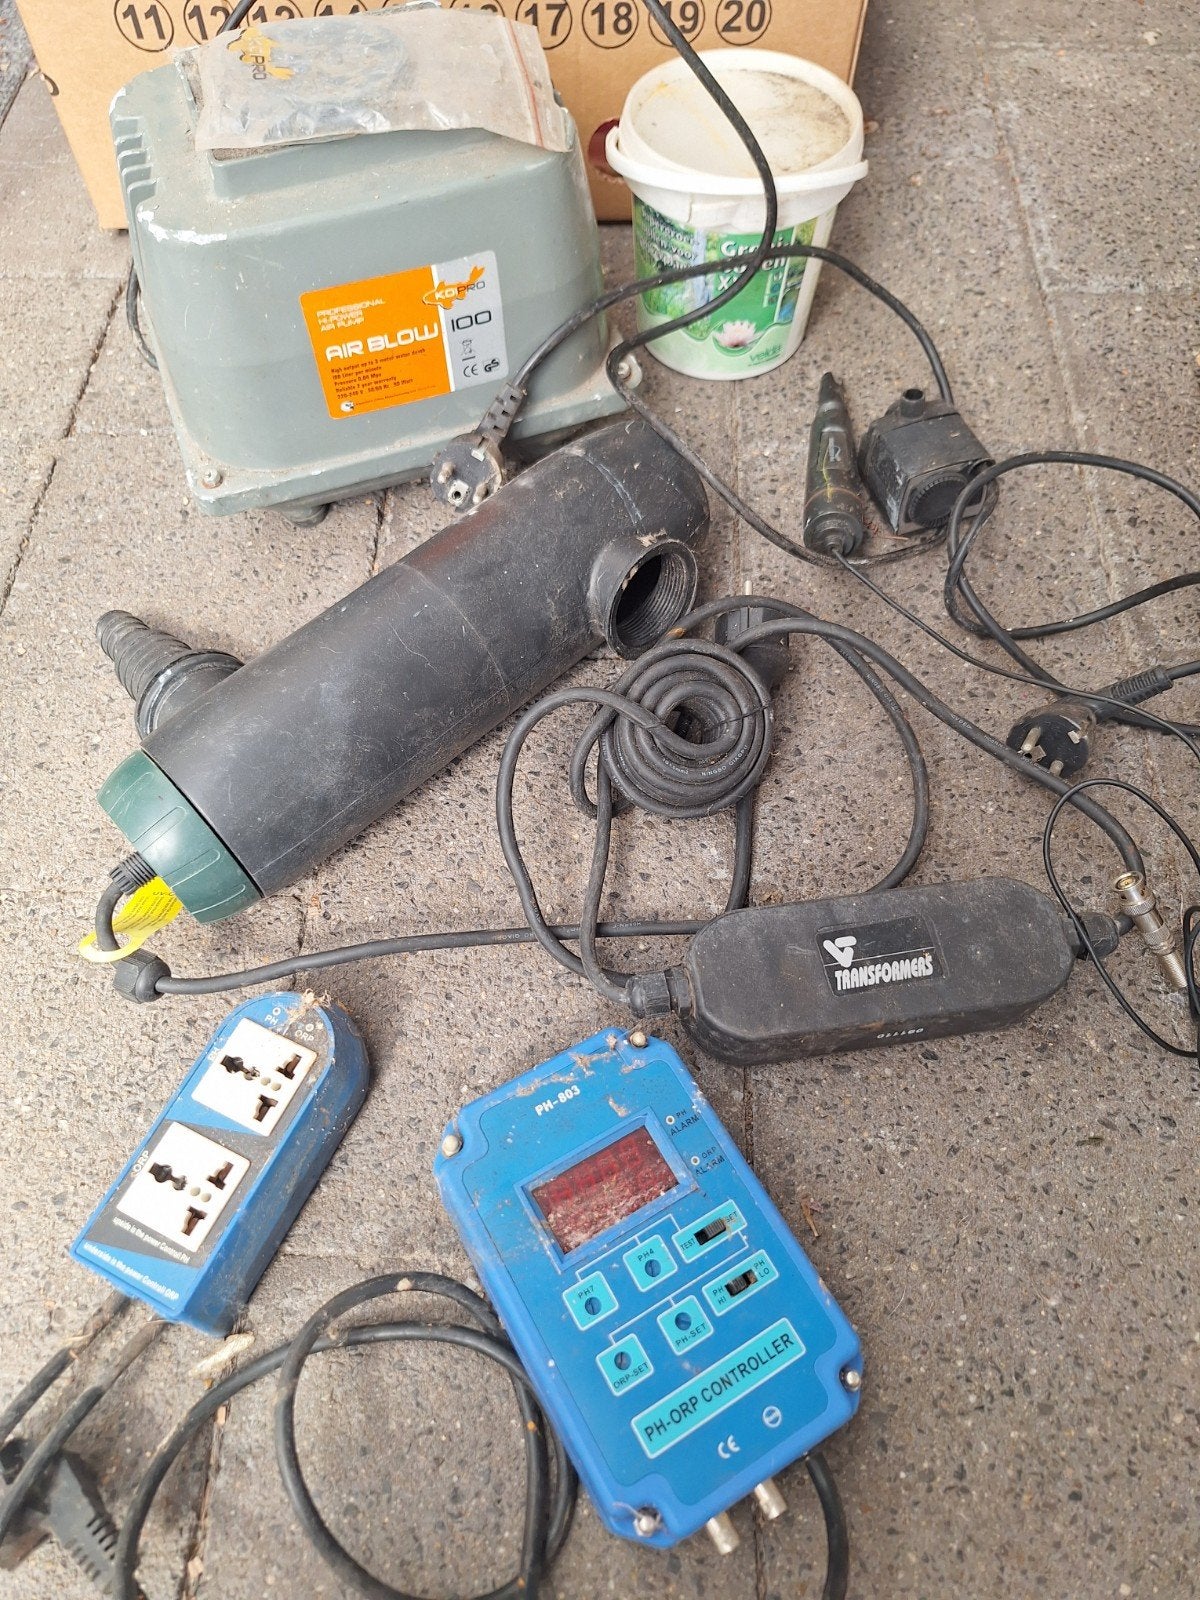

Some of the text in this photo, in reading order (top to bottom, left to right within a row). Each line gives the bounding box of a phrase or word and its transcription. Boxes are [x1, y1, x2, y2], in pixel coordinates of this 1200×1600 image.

[123, 3, 166, 40] 11
[523, 3, 567, 36] 17
[591, 2, 632, 35] 18
[722, 0, 765, 32] 20
[451, 310, 491, 332] 100
[325, 322, 439, 361] AIR BLOW
[834, 956, 933, 990] TRANSFORMERS
[264, 1014, 279, 1026] PH
[294, 1029, 315, 1041] ORP
[535, 1085, 580, 1116] PH-803
[676, 1109, 687, 1118] PH
[670, 1114, 700, 1136] ALARM
[133, 1150, 150, 1174] ORP
[726, 1211, 738, 1223] SET
[680, 1238, 696, 1251] TEST
[637, 1248, 655, 1262] PH4
[754, 1259, 766, 1270] PH
[759, 1267, 770, 1278] LO
[577, 1285, 595, 1299] PH7
[712, 1286, 724, 1297] PH
[718, 1296, 727, 1305] HI
[675, 1322, 707, 1348] PH-SET
[613, 1361, 649, 1389] ORP-SET
[644, 1333, 795, 1442] PH-ORP CONTROLLER
